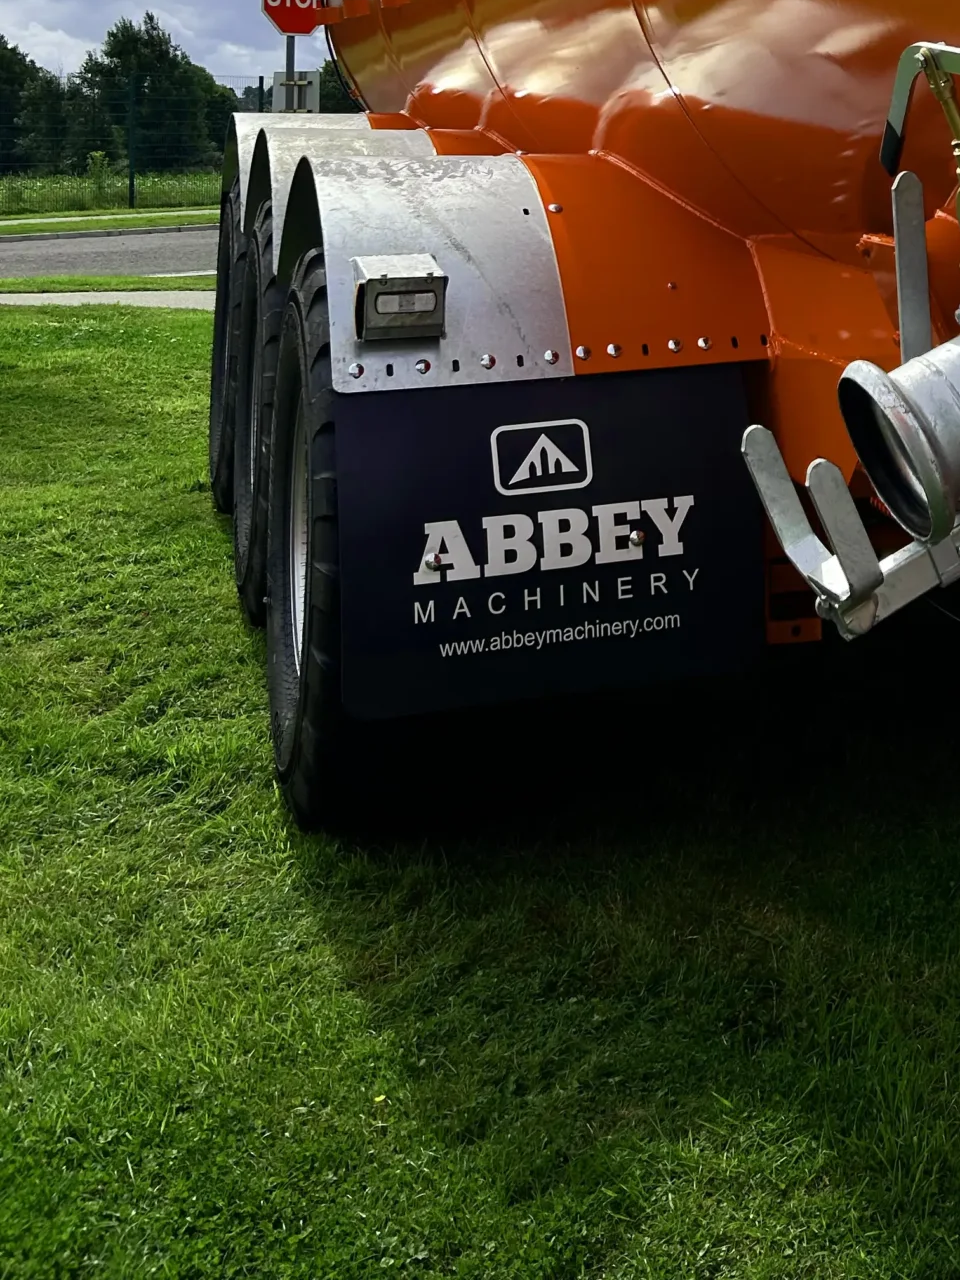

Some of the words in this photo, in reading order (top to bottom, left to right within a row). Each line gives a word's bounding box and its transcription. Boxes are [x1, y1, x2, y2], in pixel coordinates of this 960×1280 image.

[413, 495, 695, 585] ABBEY
[413, 568, 700, 625] MACHINERY
[439, 613, 681, 657] www.abbeymachinery.com
